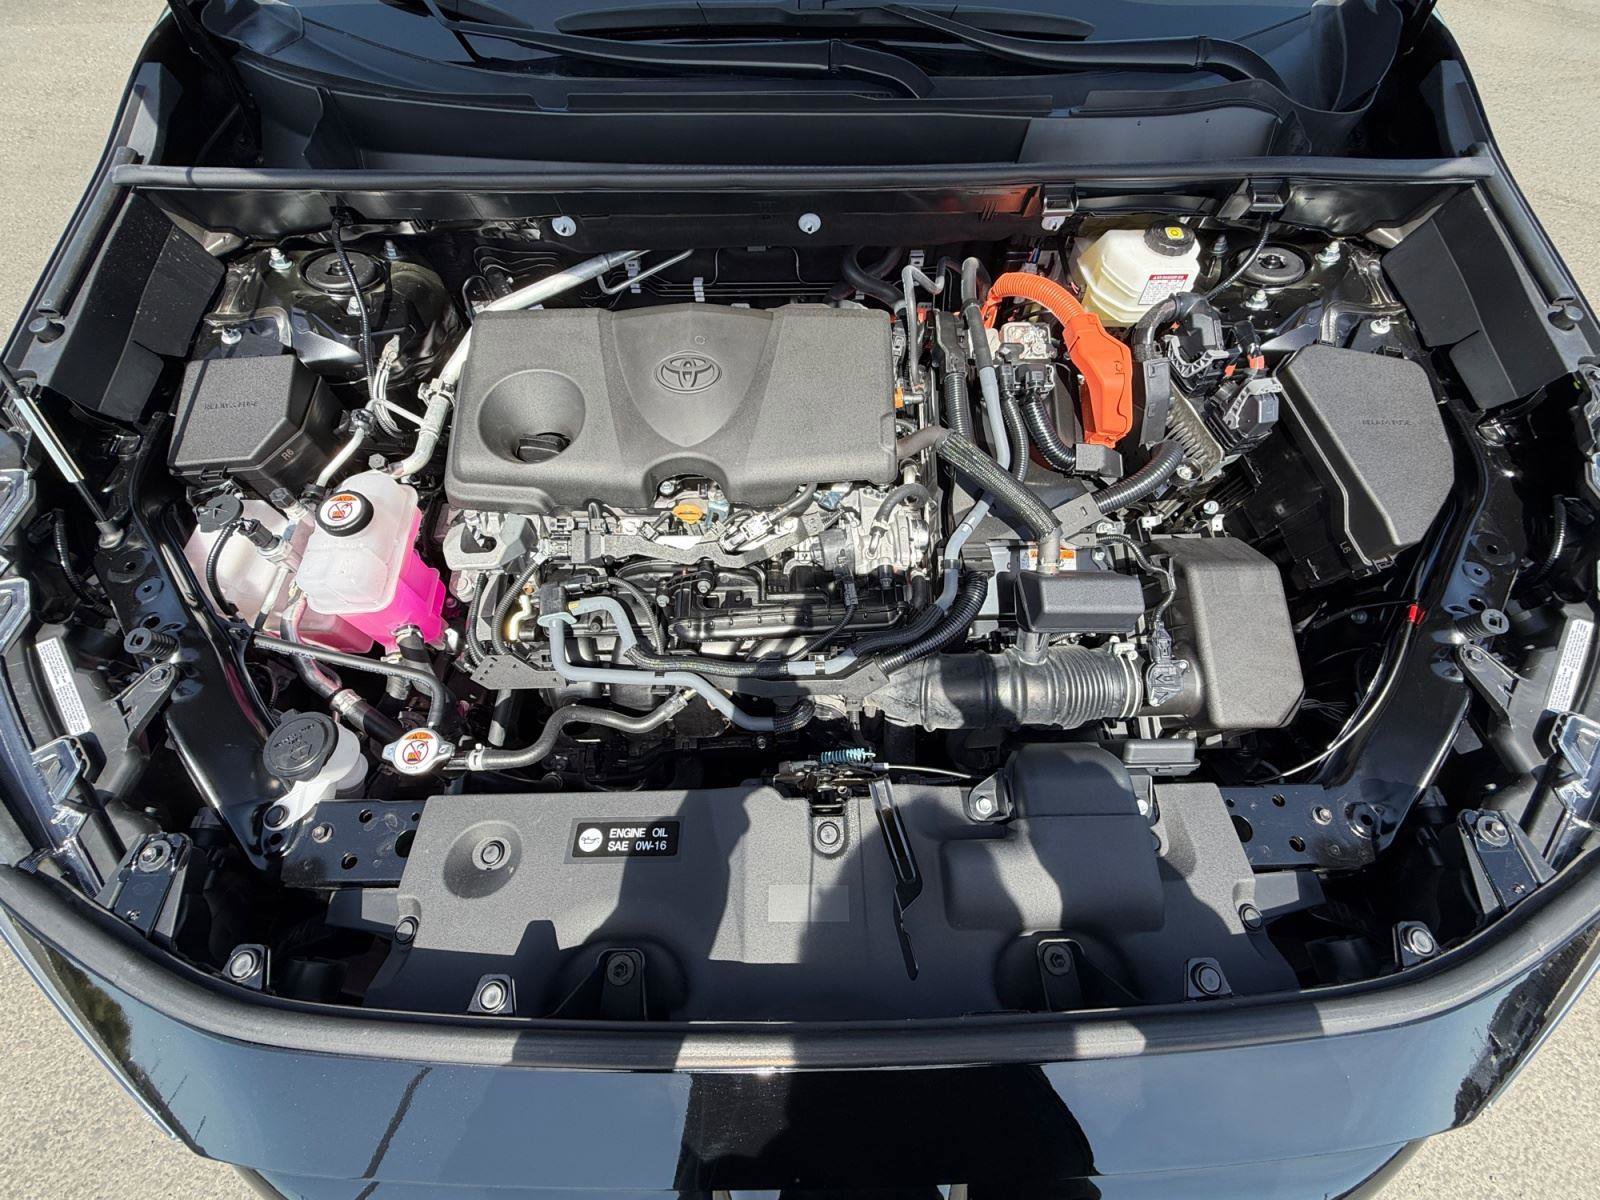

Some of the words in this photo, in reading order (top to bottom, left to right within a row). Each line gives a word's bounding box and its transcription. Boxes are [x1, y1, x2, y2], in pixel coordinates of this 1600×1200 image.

[281, 448, 294, 460] R6
[609, 827, 647, 839] ENGINE
[652, 827, 668, 838] OIL
[607, 840, 630, 852] SAE
[635, 840, 667, 851] 0W-16
